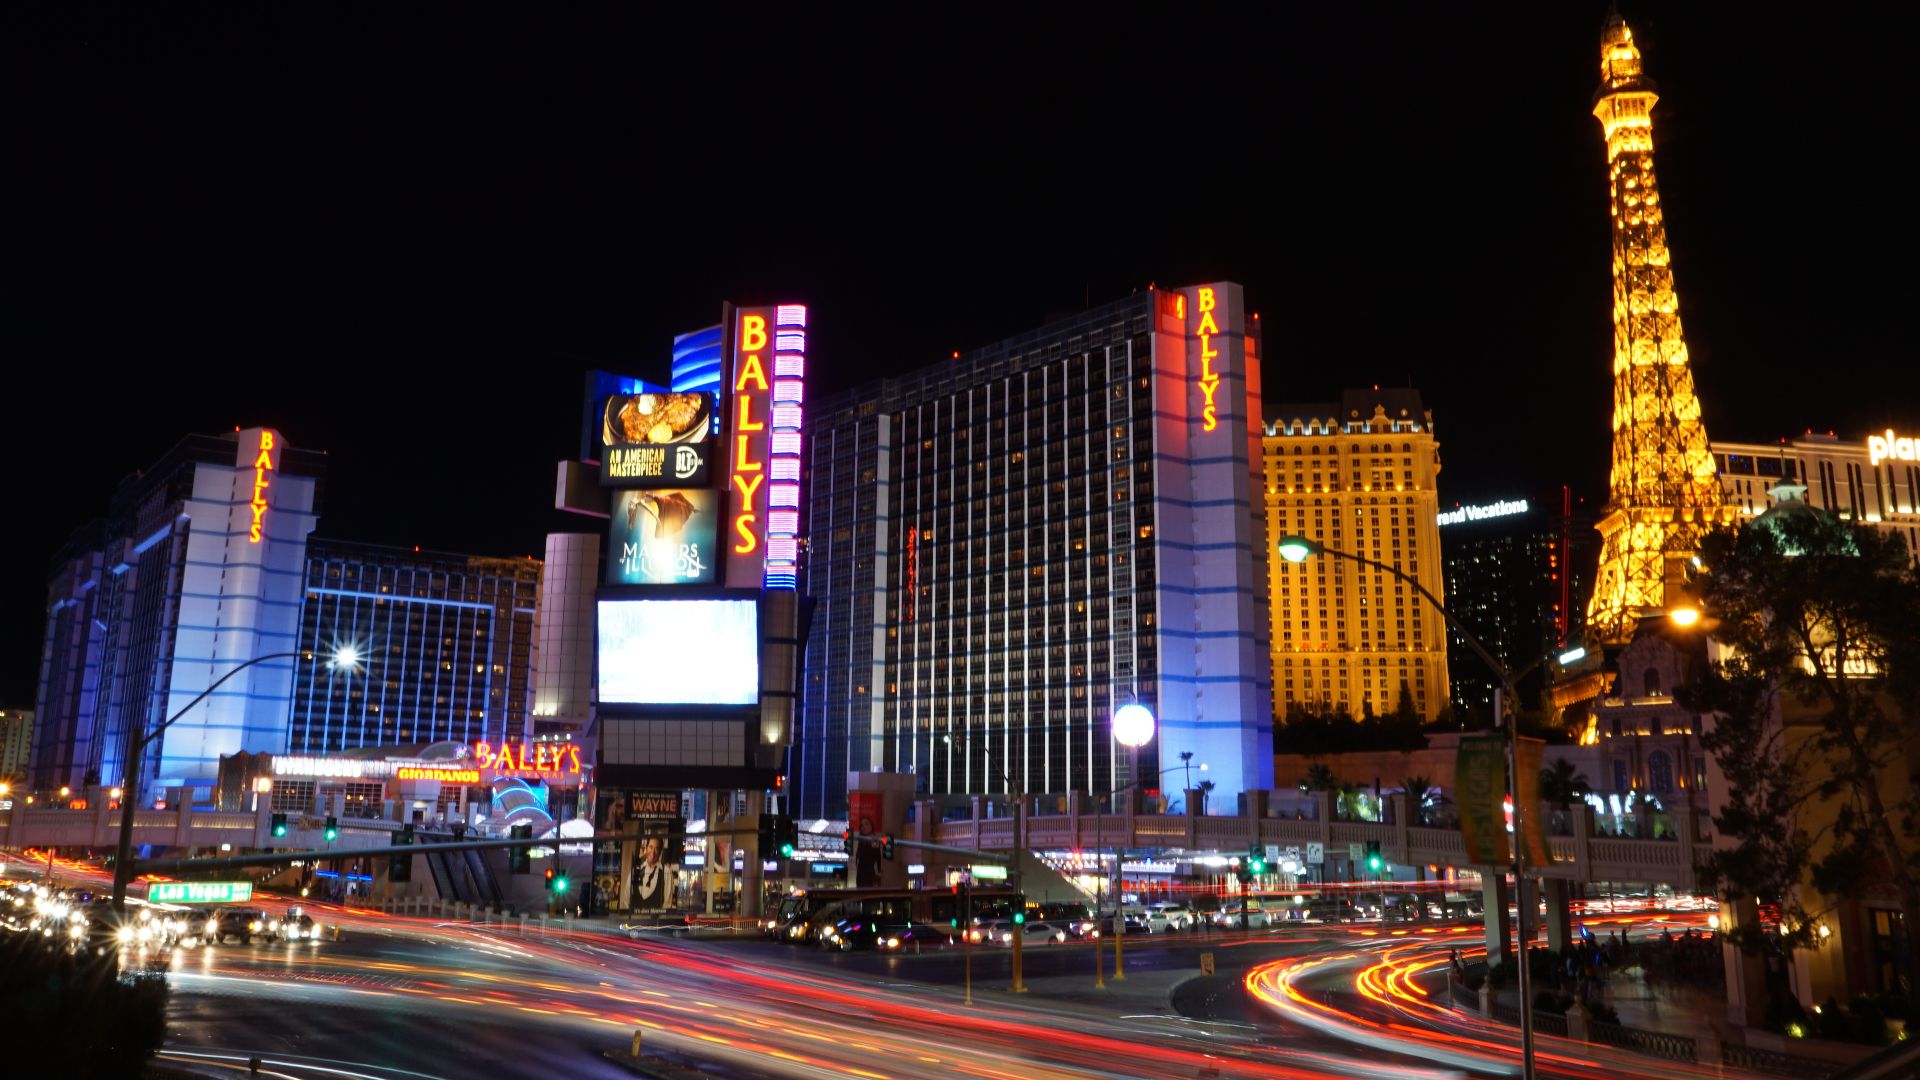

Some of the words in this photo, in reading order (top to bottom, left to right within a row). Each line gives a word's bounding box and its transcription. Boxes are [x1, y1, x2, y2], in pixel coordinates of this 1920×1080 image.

[1196, 286, 1219, 432] BALLYS
[733, 315, 769, 554] BALLYS
[610, 449, 622, 463] AN
[625, 448, 665, 463] AMERICAN
[1868, 429, 1920, 466] pla
[610, 462, 663, 477] MASTERPIECE
[249, 430, 275, 544] BALLYS
[1466, 499, 1528, 521] Vacations
[632, 798, 677, 812] WAYNE
[159, 884, 184, 899] Las
[188, 883, 229, 902] Vegas
